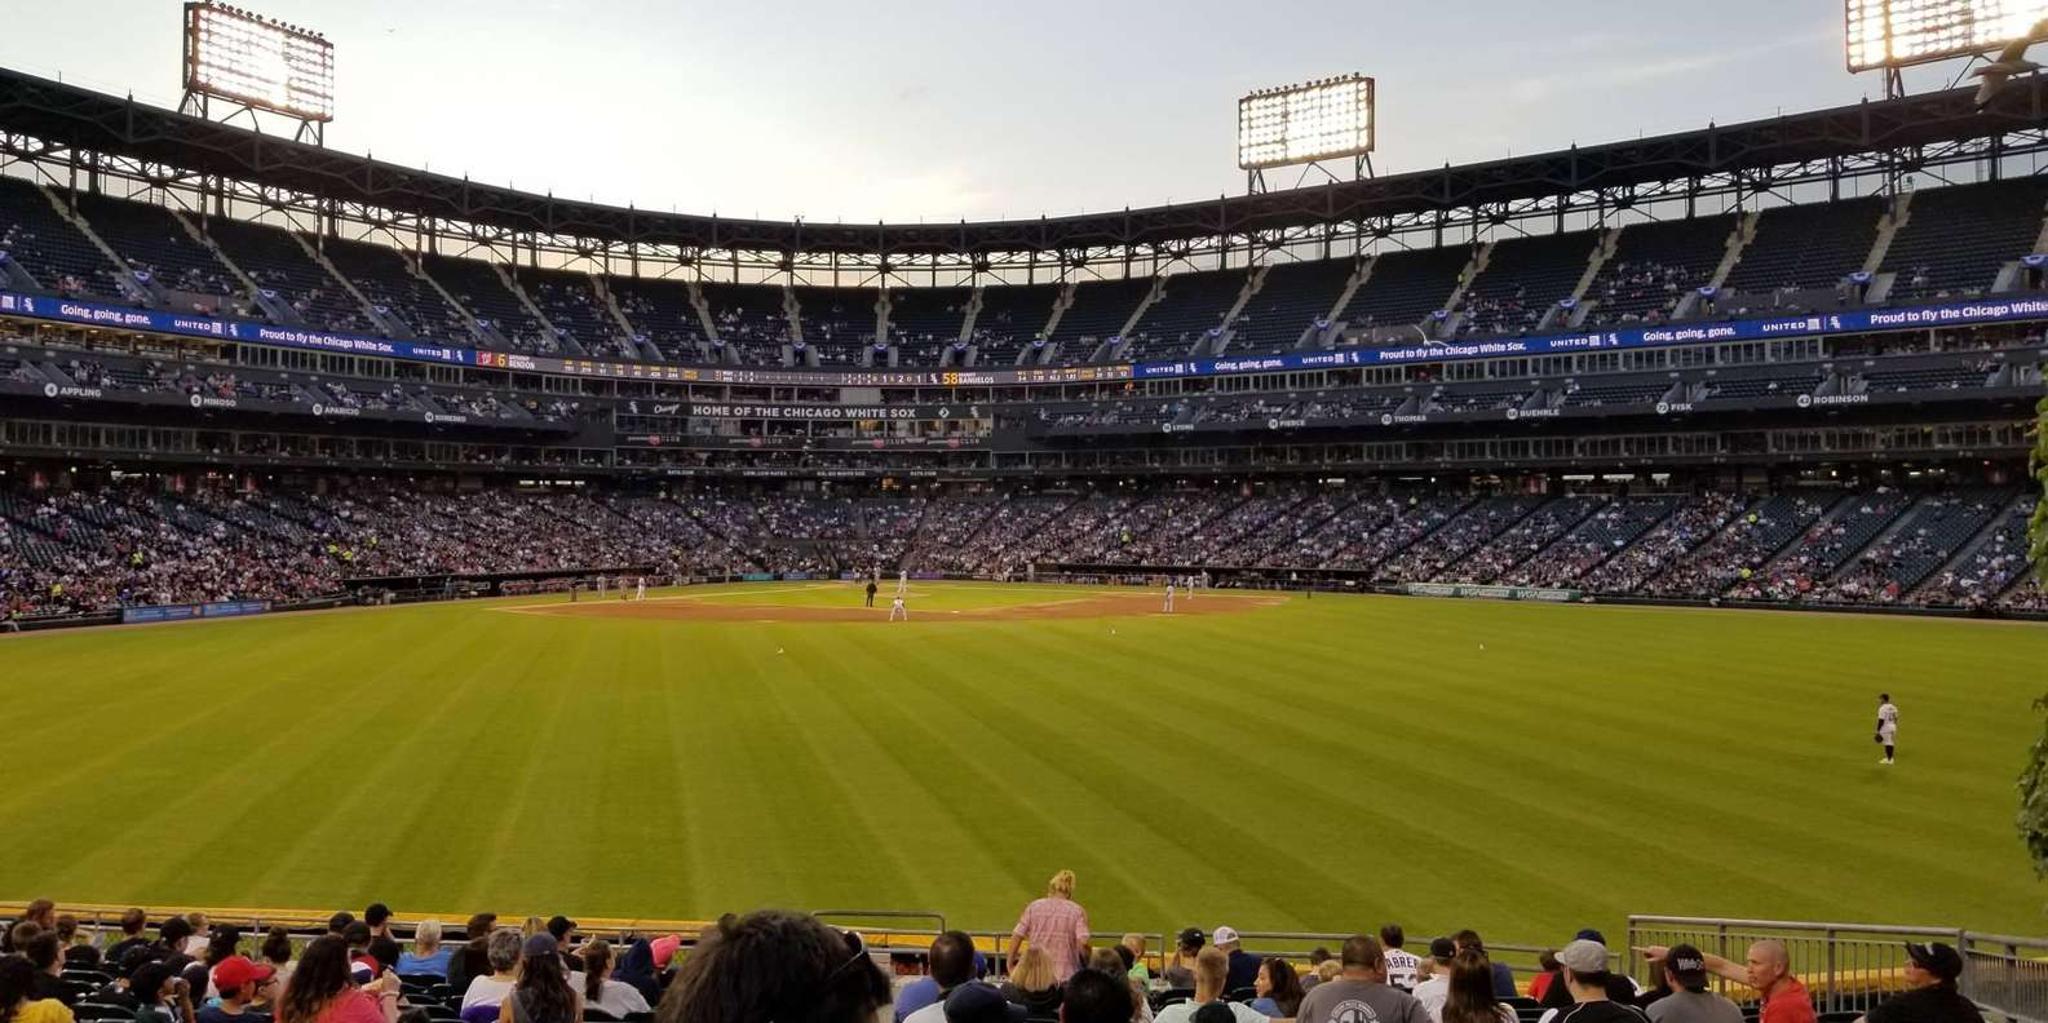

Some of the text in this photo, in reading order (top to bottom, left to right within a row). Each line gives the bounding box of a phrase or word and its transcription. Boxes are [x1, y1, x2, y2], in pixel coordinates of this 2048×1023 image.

[125, 313, 151, 325] gone.
[1870, 313, 1904, 325] Proud
[1906, 311, 1919, 322] to
[1920, 309, 1937, 322] fly
[1939, 308, 1960, 319] the
[1962, 304, 2009, 317] Chicago
[174, 319, 211, 331] UNITED
[1762, 321, 1806, 332] UNITED
[1707, 327, 1736, 338] gone.
[259, 328, 285, 341] Proud
[286, 331, 296, 341] to
[296, 332, 307, 344] fly
[309, 335, 322, 346] the
[323, 336, 353, 349] Chicago
[354, 339, 377, 351] White
[1550, 338, 1588, 348] UNITED
[412, 347, 442, 357] UNITED
[1379, 350, 1405, 360] Proud
[1406, 350, 1415, 359] to
[1416, 347, 1428, 360] fly
[1429, 347, 1444, 357] the
[1445, 345, 1478, 357] Chicago
[1479, 342, 1506, 353] White
[497, 353, 506, 367] 6
[1302, 355, 1334, 365] UNITED
[1146, 366, 1174, 375] UNITED
[898, 375, 904, 383] 2
[942, 372, 958, 384] 58
[60, 387, 102, 398] APPLING
[1813, 394, 1869, 404] ROBINSON
[692, 405, 730, 416] HOME
[733, 406, 751, 416] OF
[754, 407, 780, 417] THE
[783, 407, 842, 418] CHICAGO
[845, 408, 887, 418] WHITE
[890, 408, 917, 418] SOX
